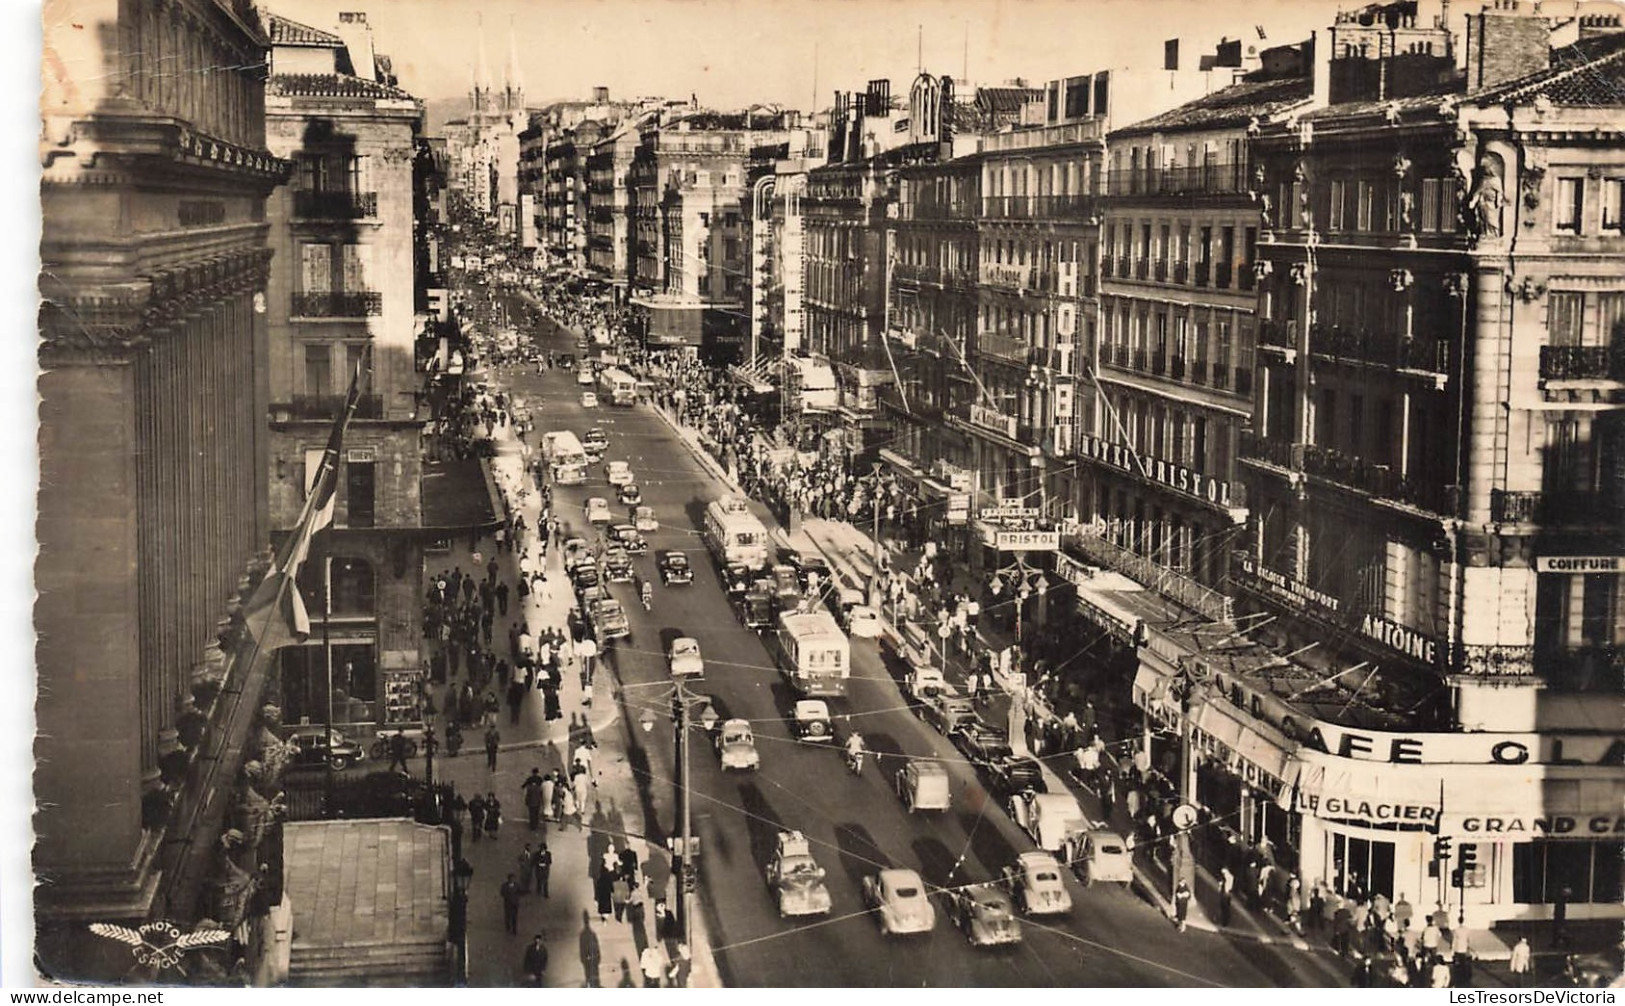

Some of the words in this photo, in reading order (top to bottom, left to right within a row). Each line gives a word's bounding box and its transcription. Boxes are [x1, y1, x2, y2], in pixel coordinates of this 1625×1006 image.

[1081, 434, 1132, 471] HOTEL
[1145, 456, 1231, 507] BRISTOL
[1000, 534, 1056, 544] BRISTOL
[1548, 558, 1618, 570] COIFFURE
[1361, 613, 1436, 665] ANTOINE
[1299, 792, 1319, 811] LE
[1325, 798, 1436, 820] GLACIER
[1463, 816, 1576, 834] GRAND
